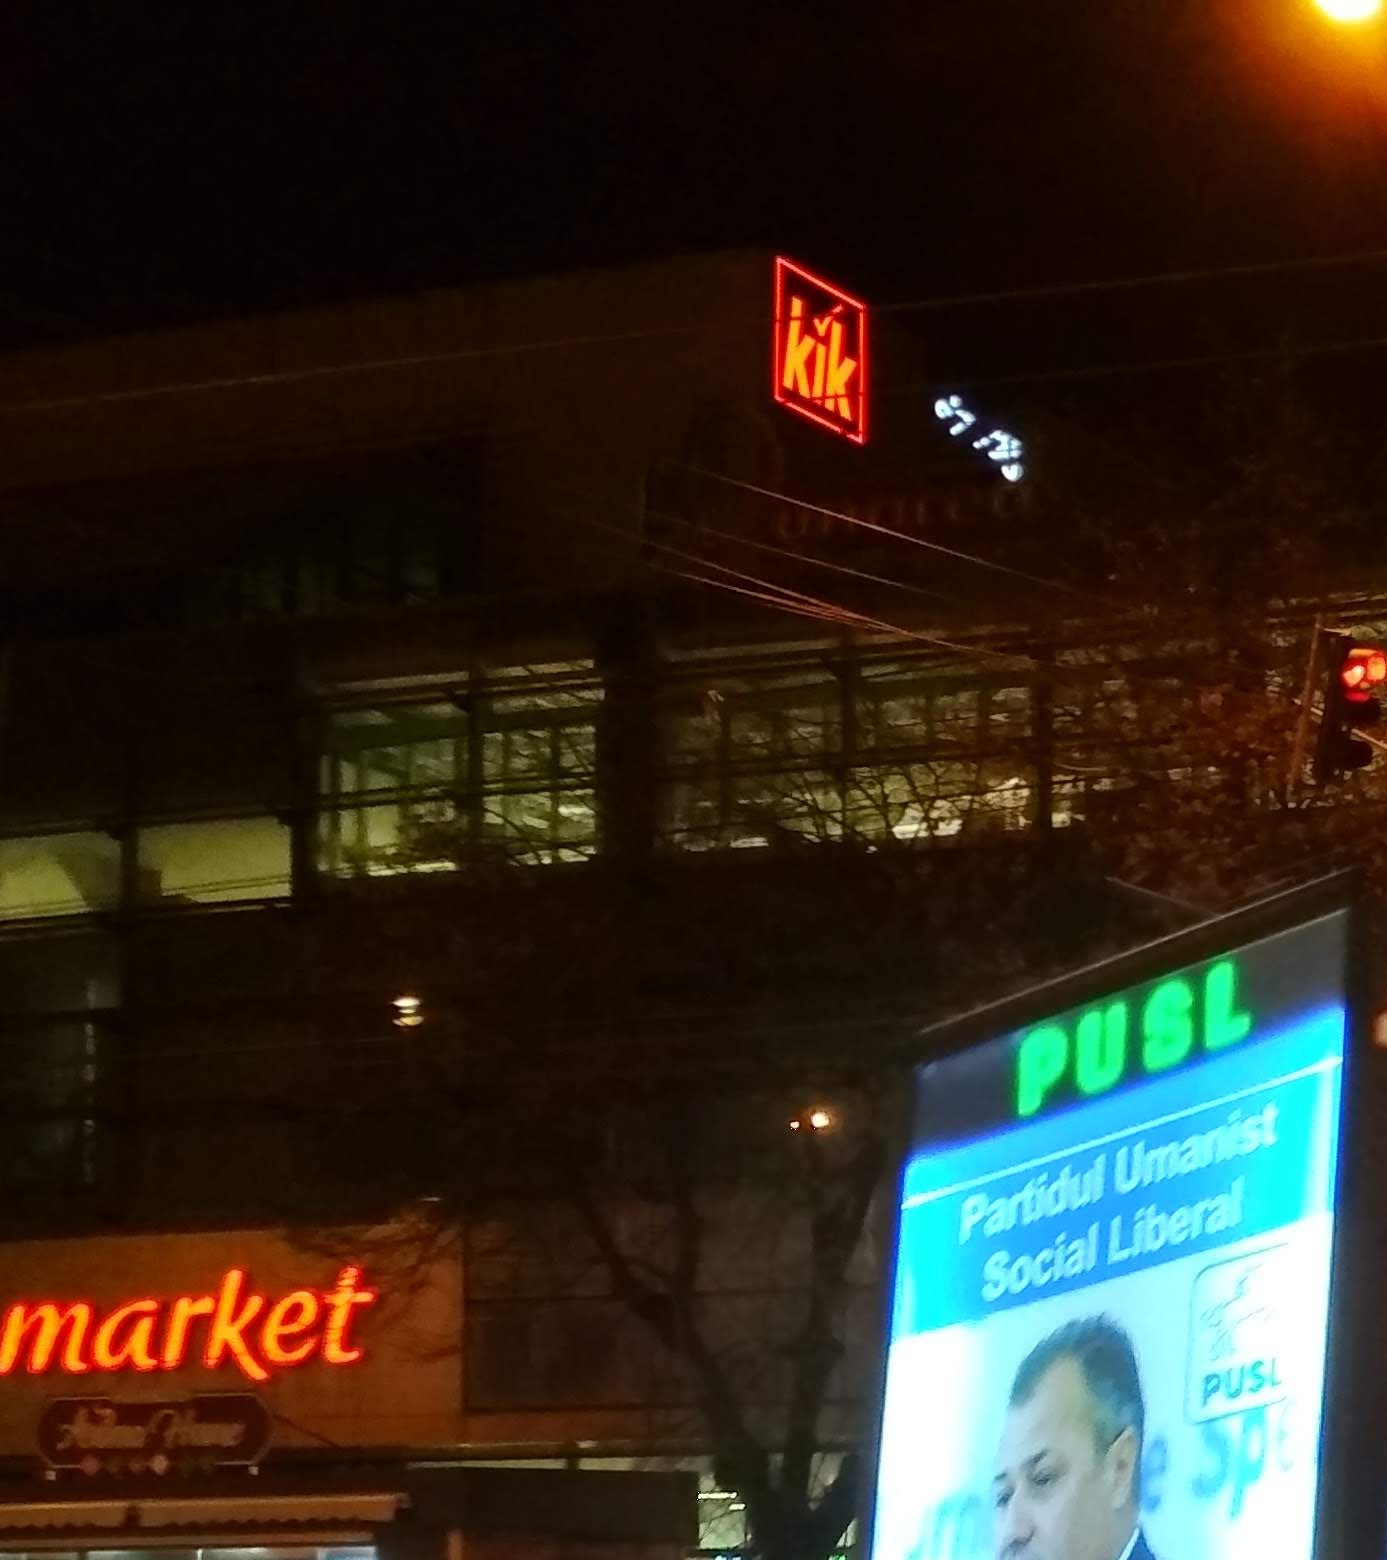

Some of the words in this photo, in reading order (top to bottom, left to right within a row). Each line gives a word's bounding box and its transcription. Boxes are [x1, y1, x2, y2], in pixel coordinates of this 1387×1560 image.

[783, 296, 857, 422] kik
[1016, 960, 1252, 1118] PUSL
[958, 1156, 1106, 1245] Partidul
[1114, 1103, 1280, 1191] Umanist
[981, 1227, 1097, 1302] Social
[1107, 1179, 1247, 1265] Liberal
[0, 1264, 378, 1381] market
[1201, 1357, 1282, 1408] PUSL
